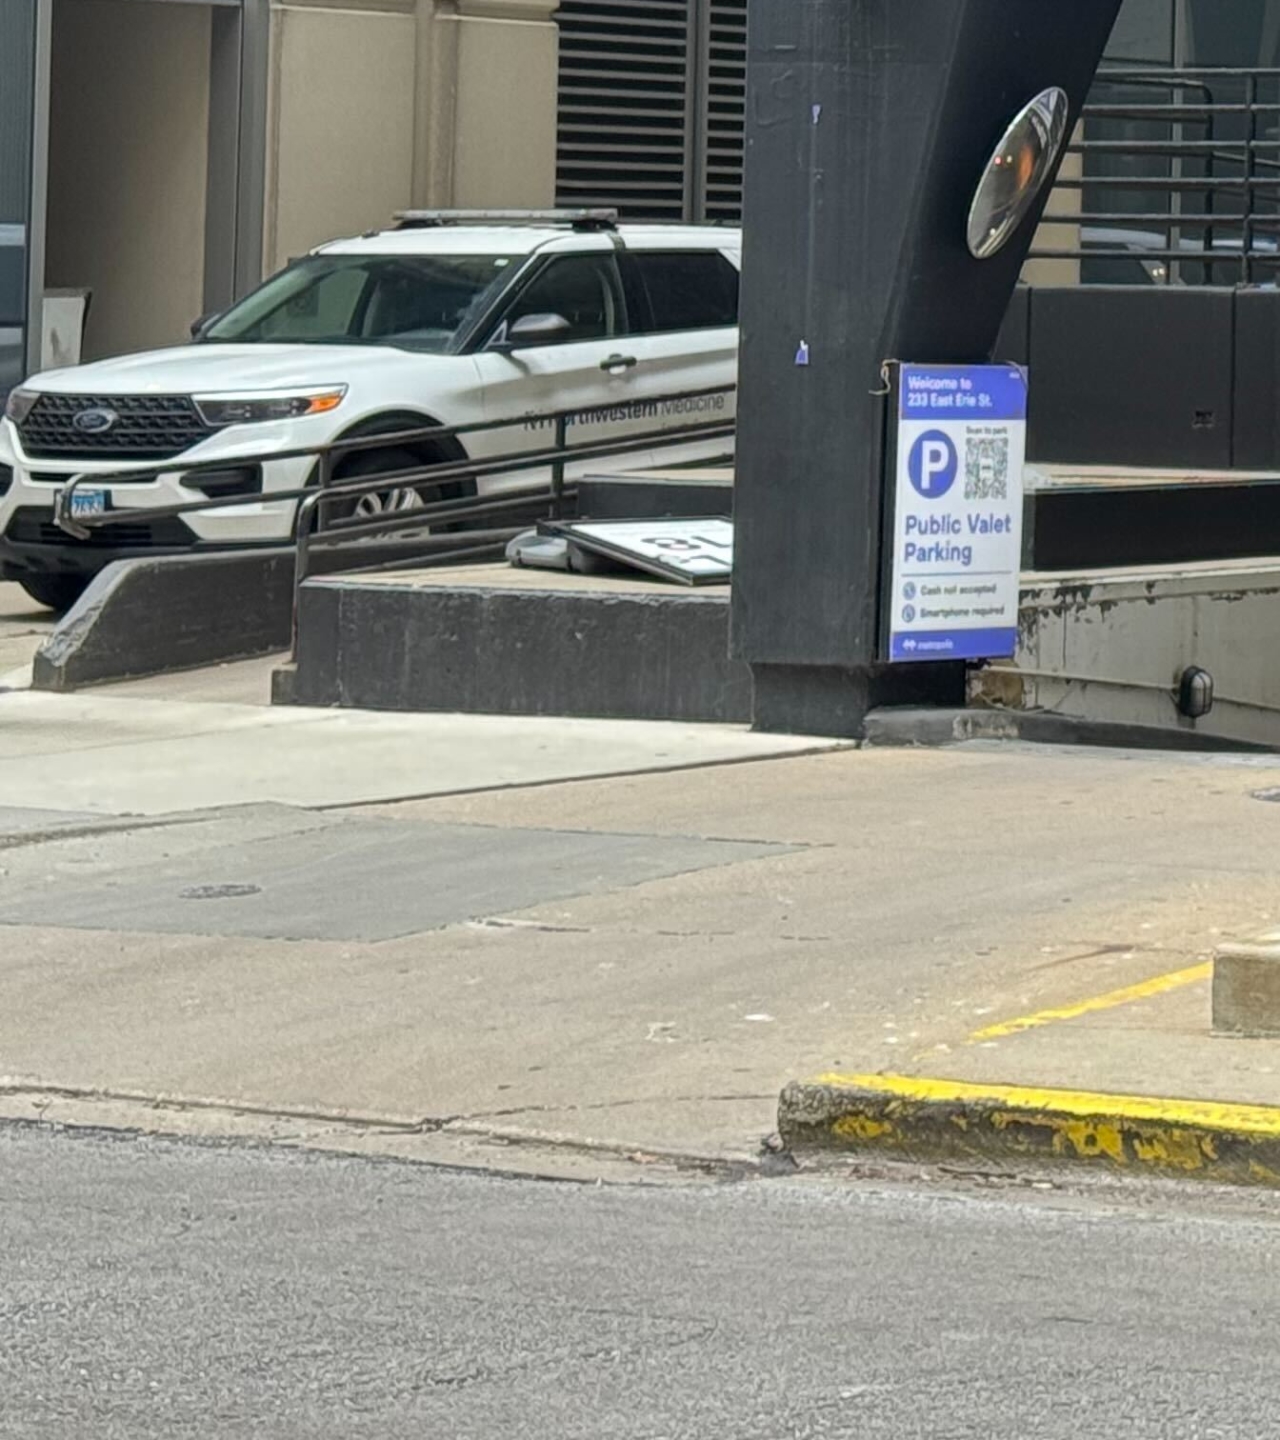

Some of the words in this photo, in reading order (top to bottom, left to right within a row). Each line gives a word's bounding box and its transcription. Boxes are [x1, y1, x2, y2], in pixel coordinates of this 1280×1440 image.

[907, 375, 958, 390] Welcome
[960, 377, 973, 391] to
[907, 392, 929, 408] 233
[930, 392, 954, 408] East
[955, 392, 977, 408] Erie
[978, 392, 993, 408] St.
[904, 512, 962, 536] Public
[967, 512, 1012, 534] Valet
[904, 540, 972, 567] Parking
[920, 584, 941, 596] Cash
[959, 583, 997, 597] accepted
